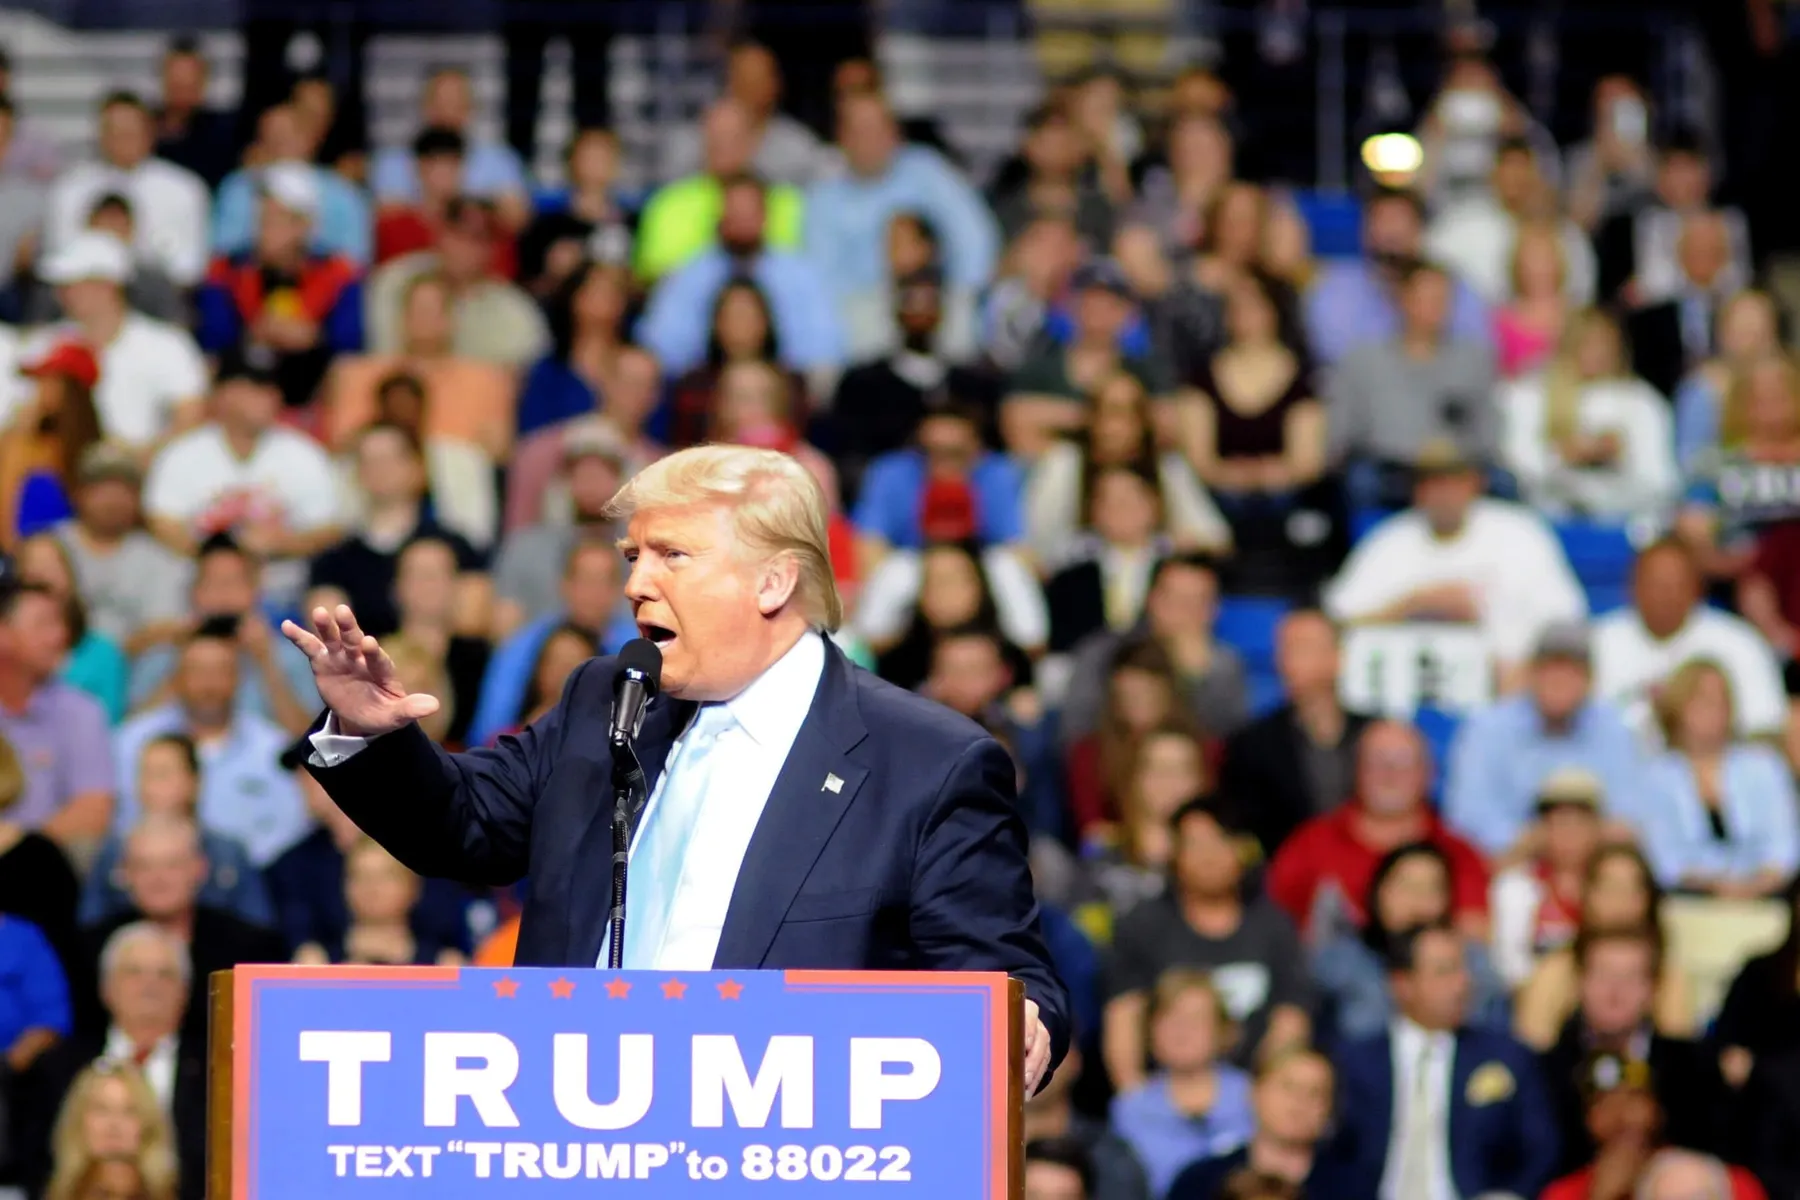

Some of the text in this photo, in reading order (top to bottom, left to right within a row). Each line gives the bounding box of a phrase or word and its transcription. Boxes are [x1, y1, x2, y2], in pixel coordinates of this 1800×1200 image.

[299, 1030, 942, 1130] TRUMP
[327, 1144, 441, 1178] TEXT
[687, 1151, 729, 1180] to
[740, 1144, 912, 1181] 88022
